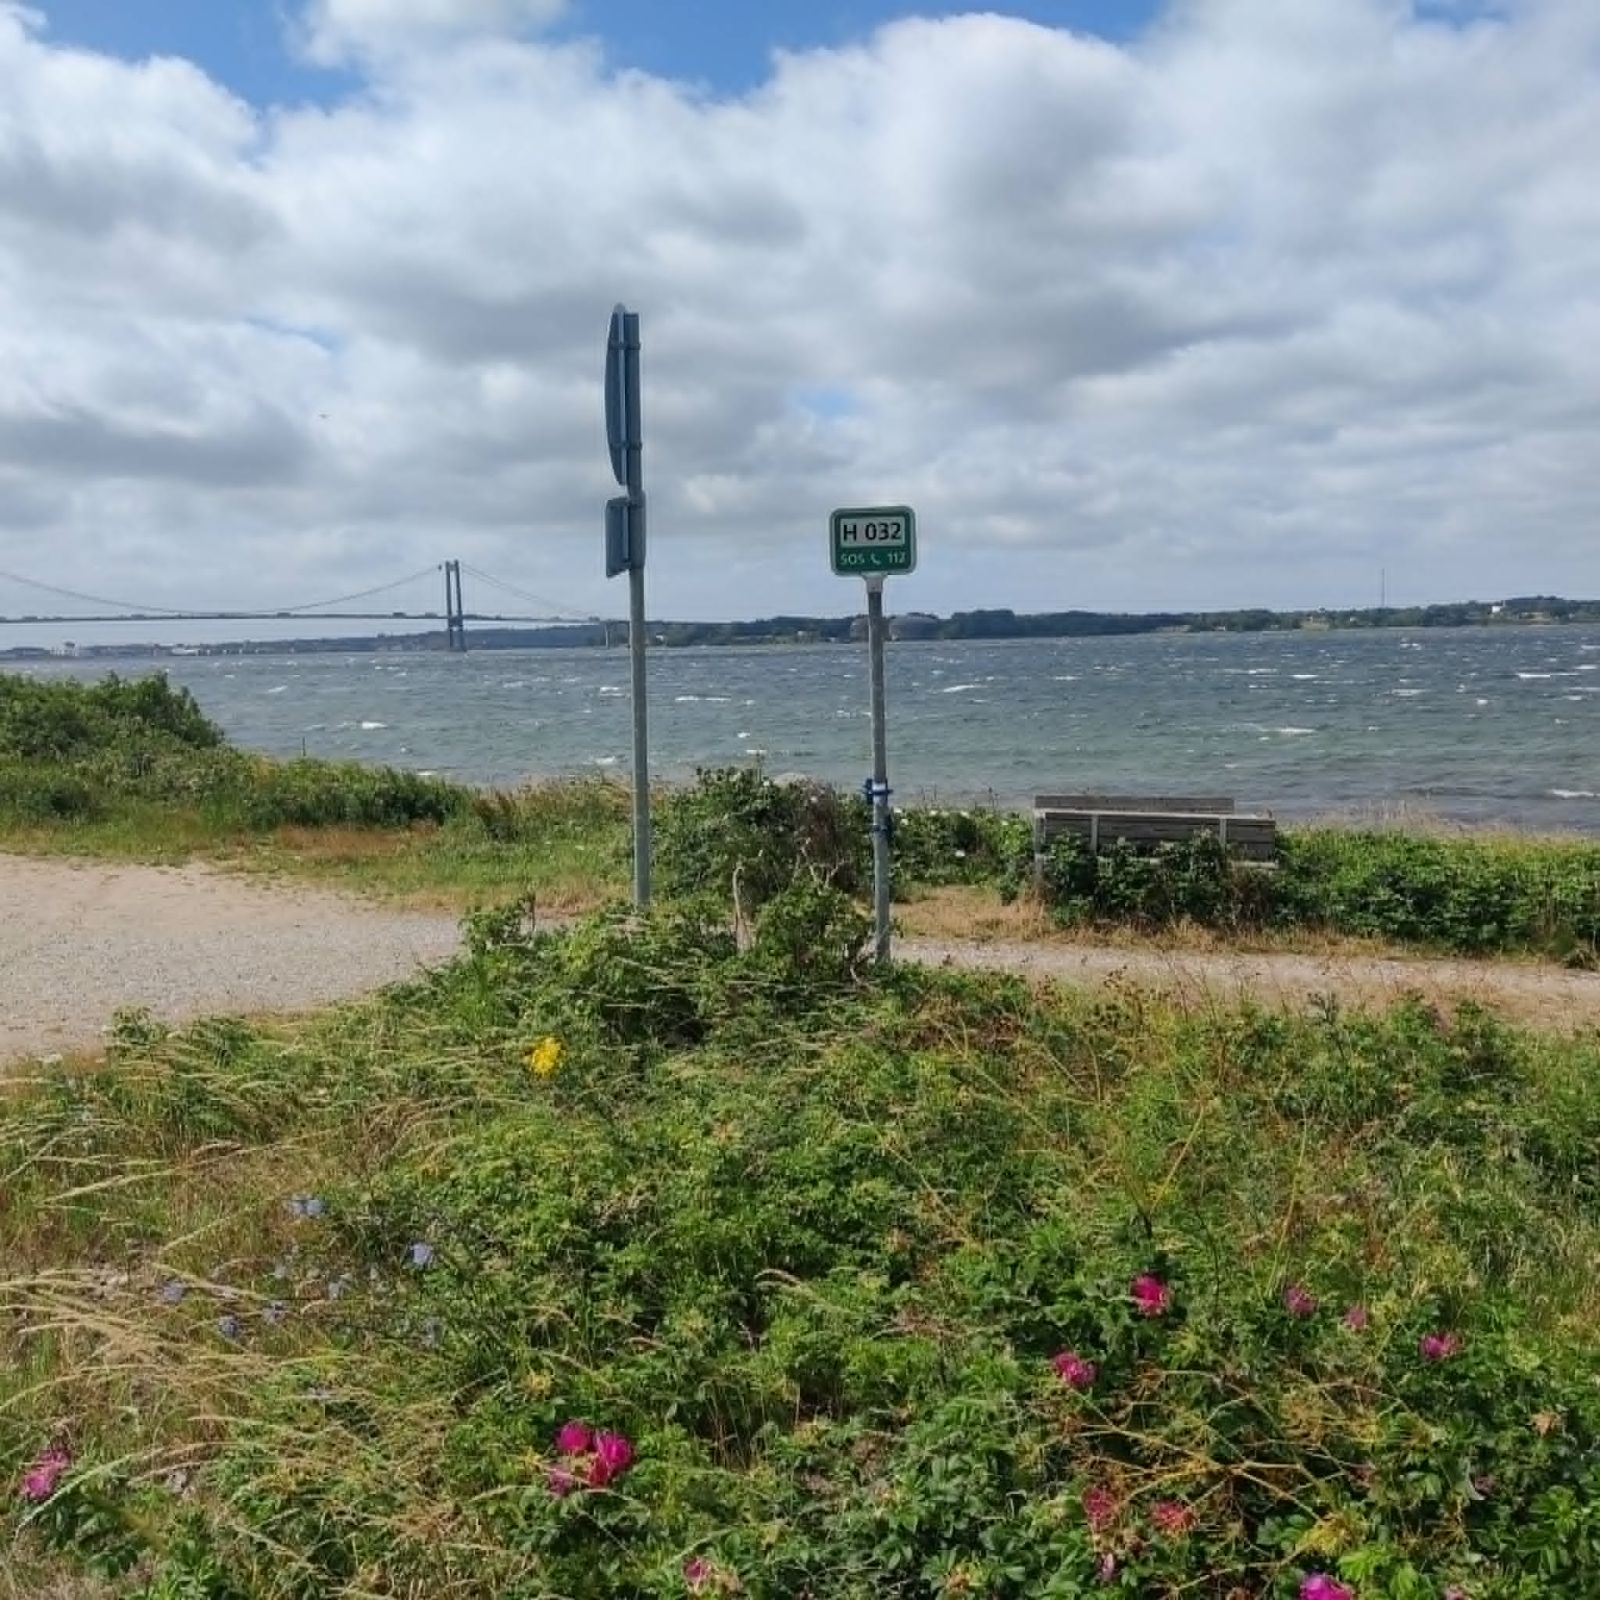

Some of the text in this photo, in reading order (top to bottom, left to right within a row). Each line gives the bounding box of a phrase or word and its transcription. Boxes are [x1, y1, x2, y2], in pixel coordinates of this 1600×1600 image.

[843, 522, 901, 541] H 032
[840, 551, 906, 565] SOS 112
